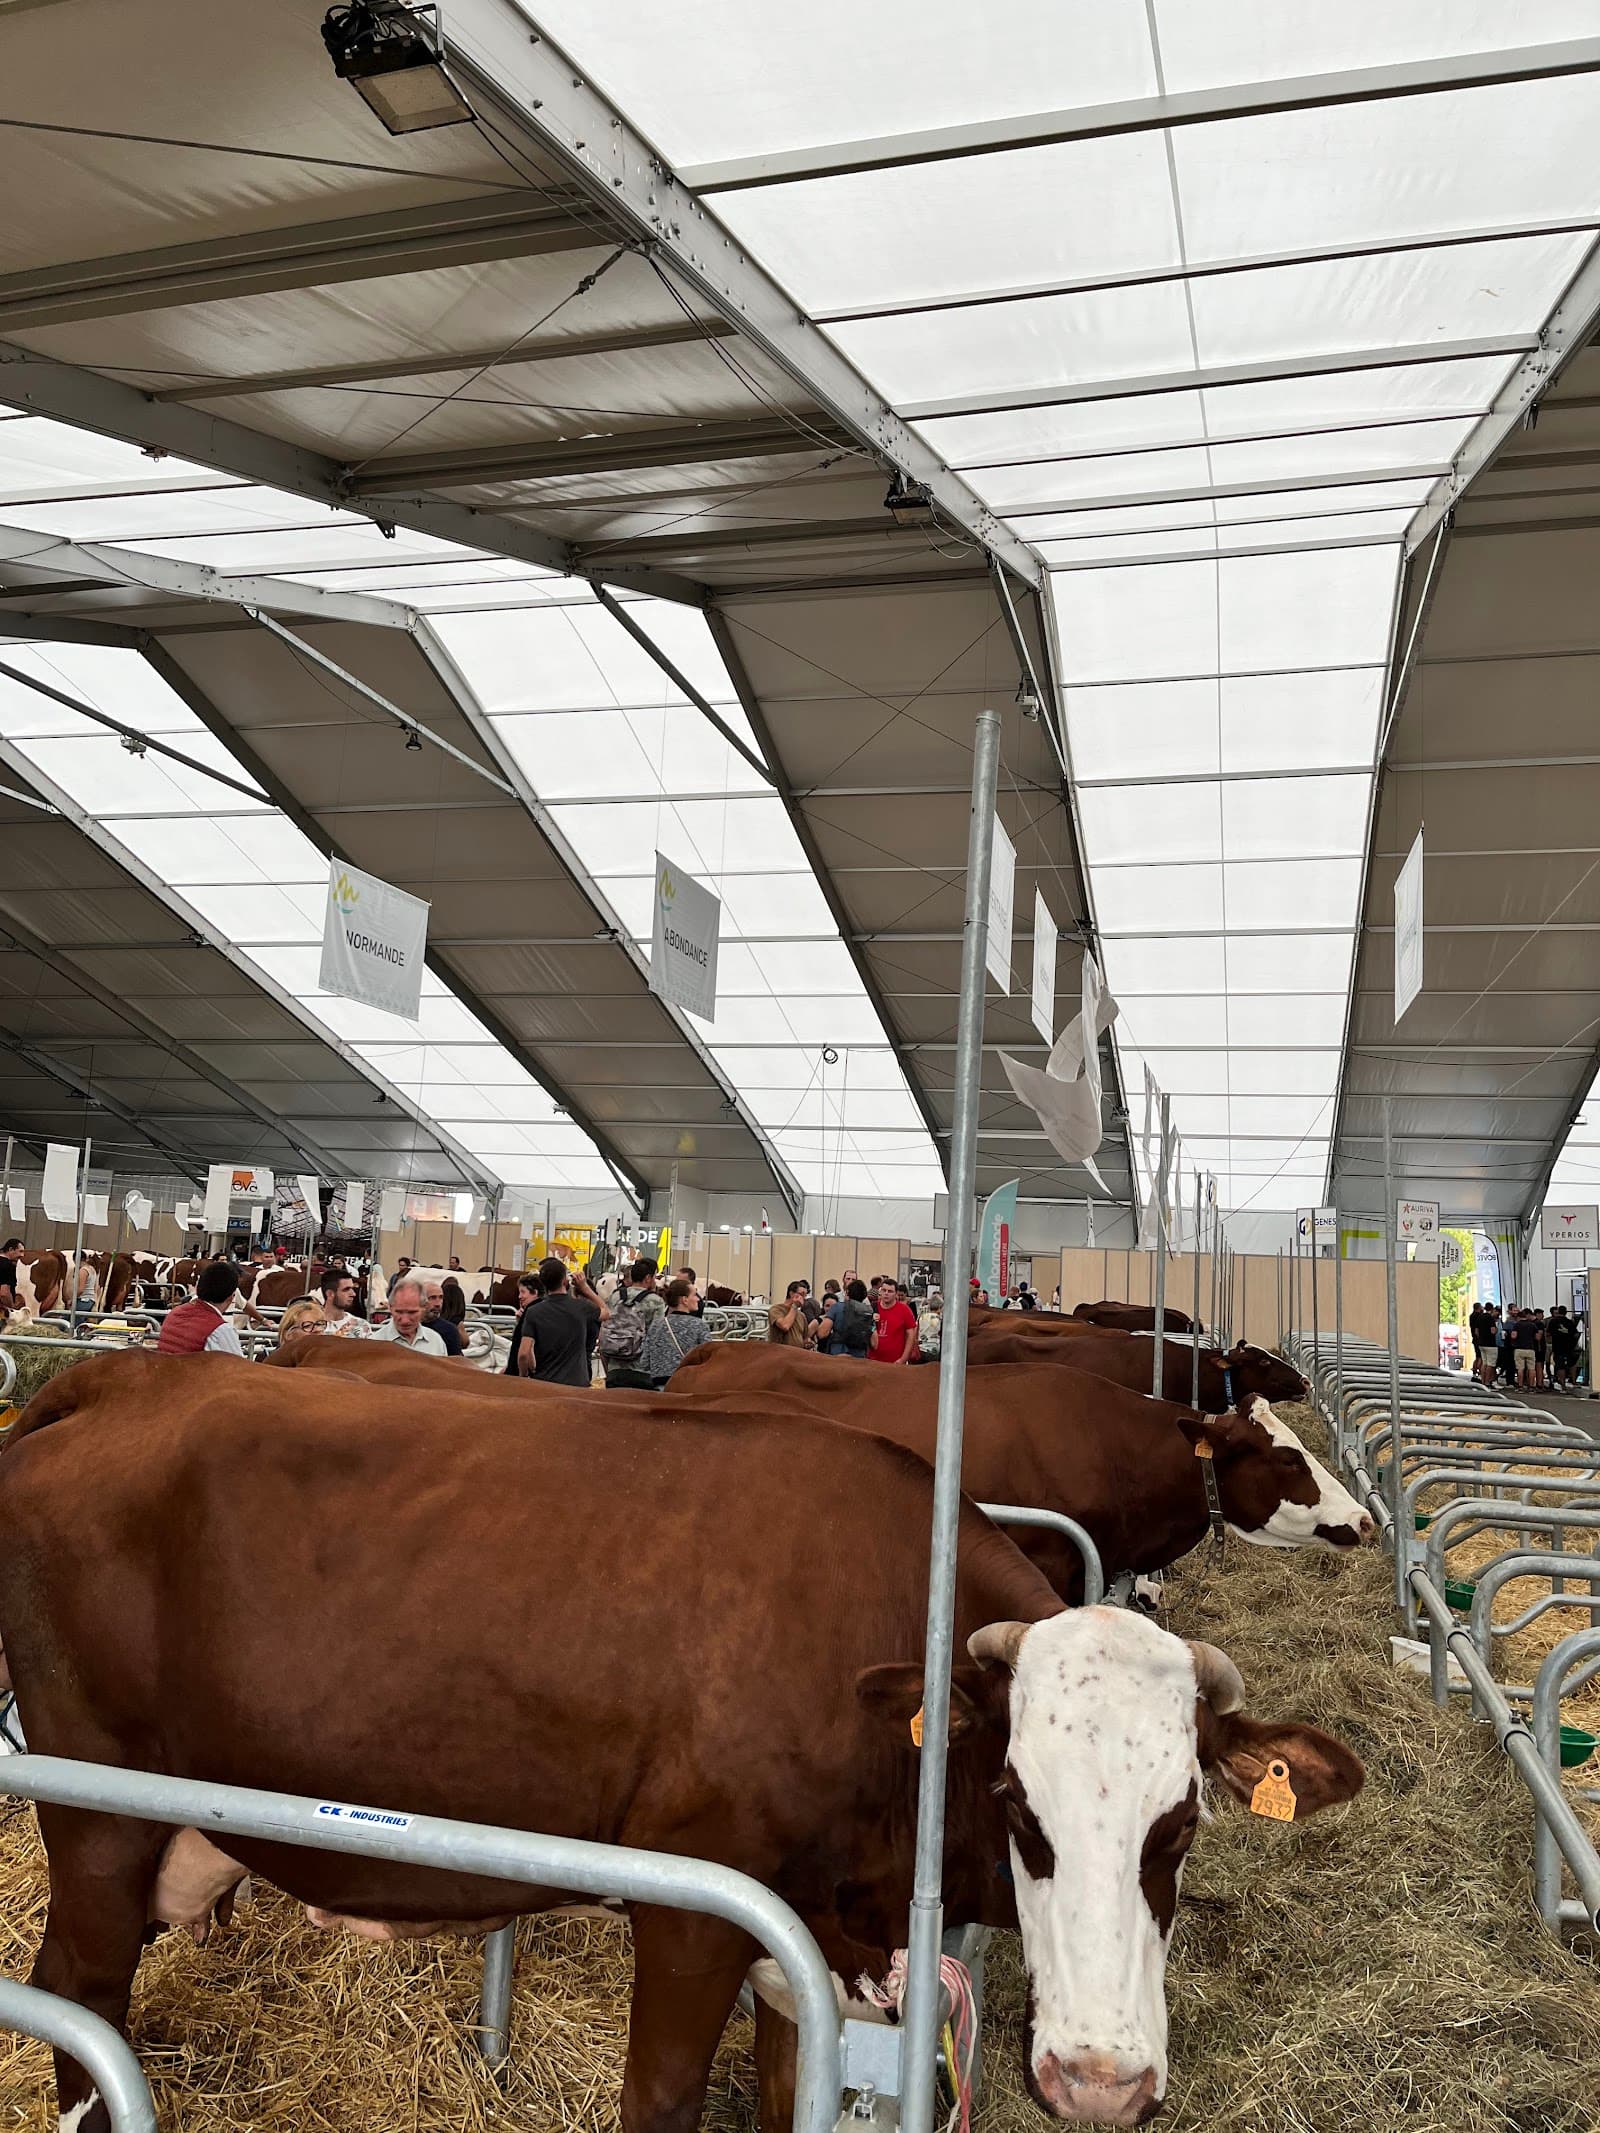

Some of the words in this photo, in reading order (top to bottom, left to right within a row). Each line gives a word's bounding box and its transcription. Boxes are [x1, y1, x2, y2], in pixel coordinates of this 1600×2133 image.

[346, 928, 405, 967] NORMANDE
[664, 927, 708, 968] ABONDANCE
[1411, 1205, 1434, 1214] AURIVA
[1549, 1231, 1590, 1239] YPERIOS
[319, 1805, 342, 1816] CK
[349, 1809, 409, 1827] INDUSTRIES
[1254, 1796, 1292, 1819] 7932
